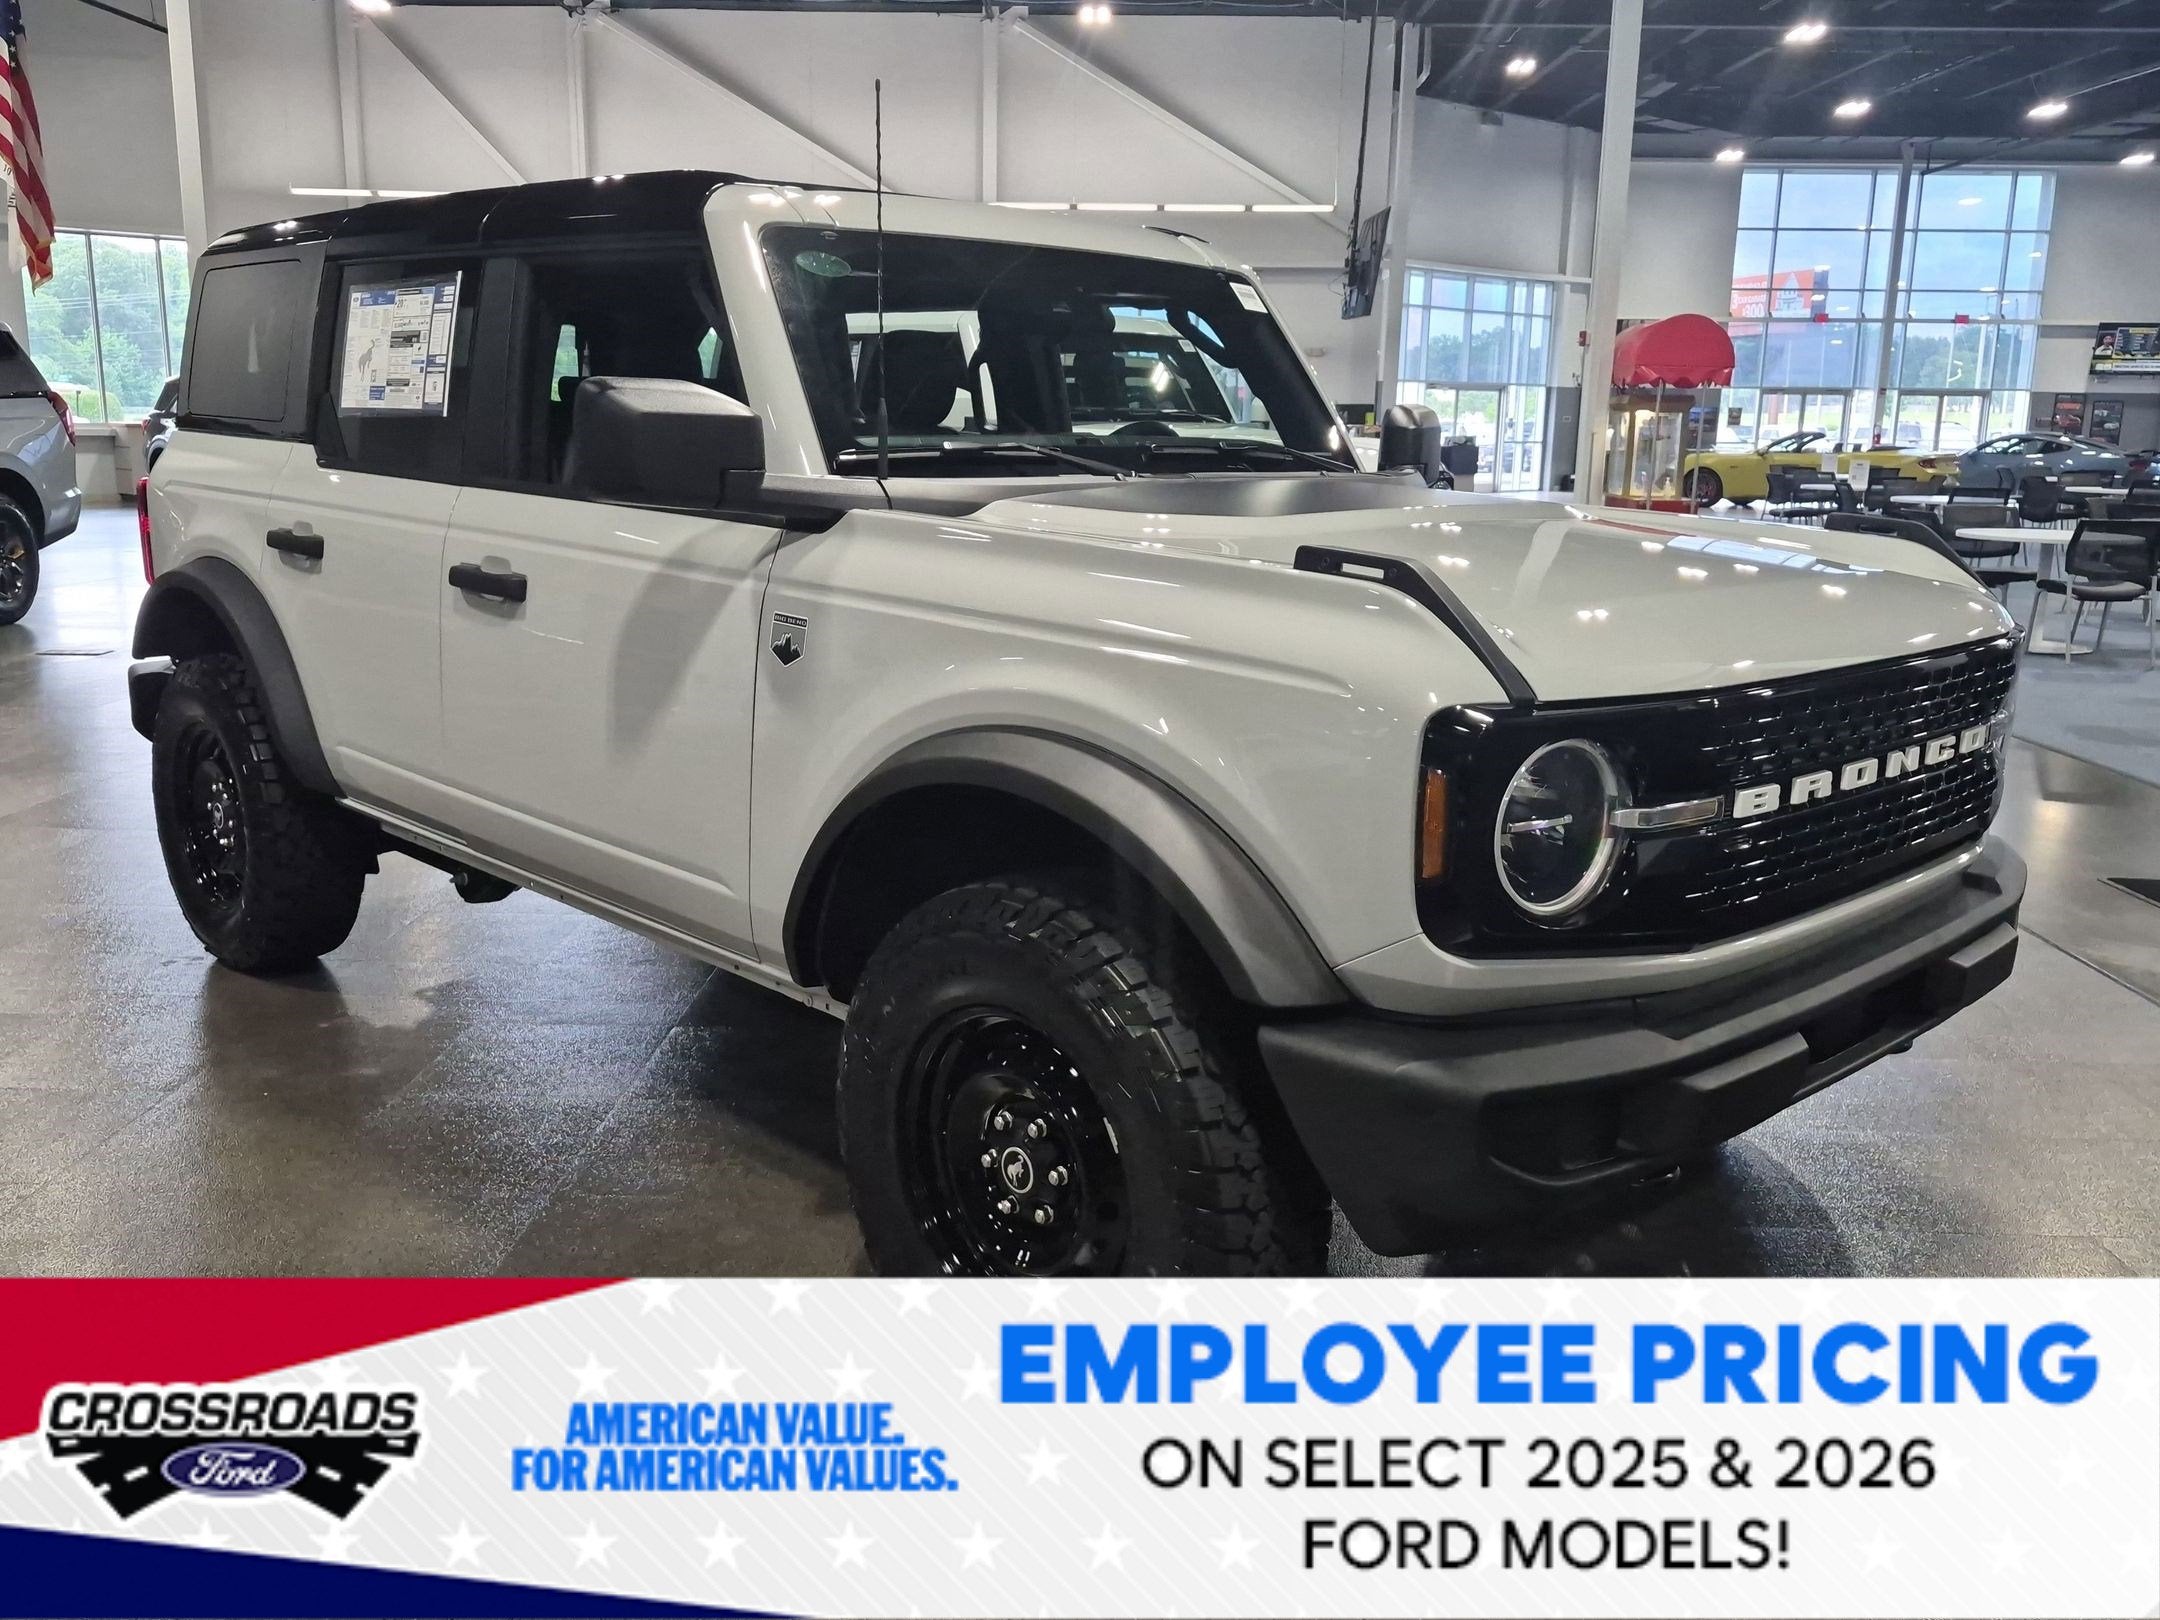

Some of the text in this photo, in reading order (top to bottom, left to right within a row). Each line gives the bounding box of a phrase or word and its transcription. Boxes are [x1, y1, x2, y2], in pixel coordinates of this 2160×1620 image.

[774, 614, 807, 626] BIG BEND
[1733, 724, 1992, 819] BRONCO
